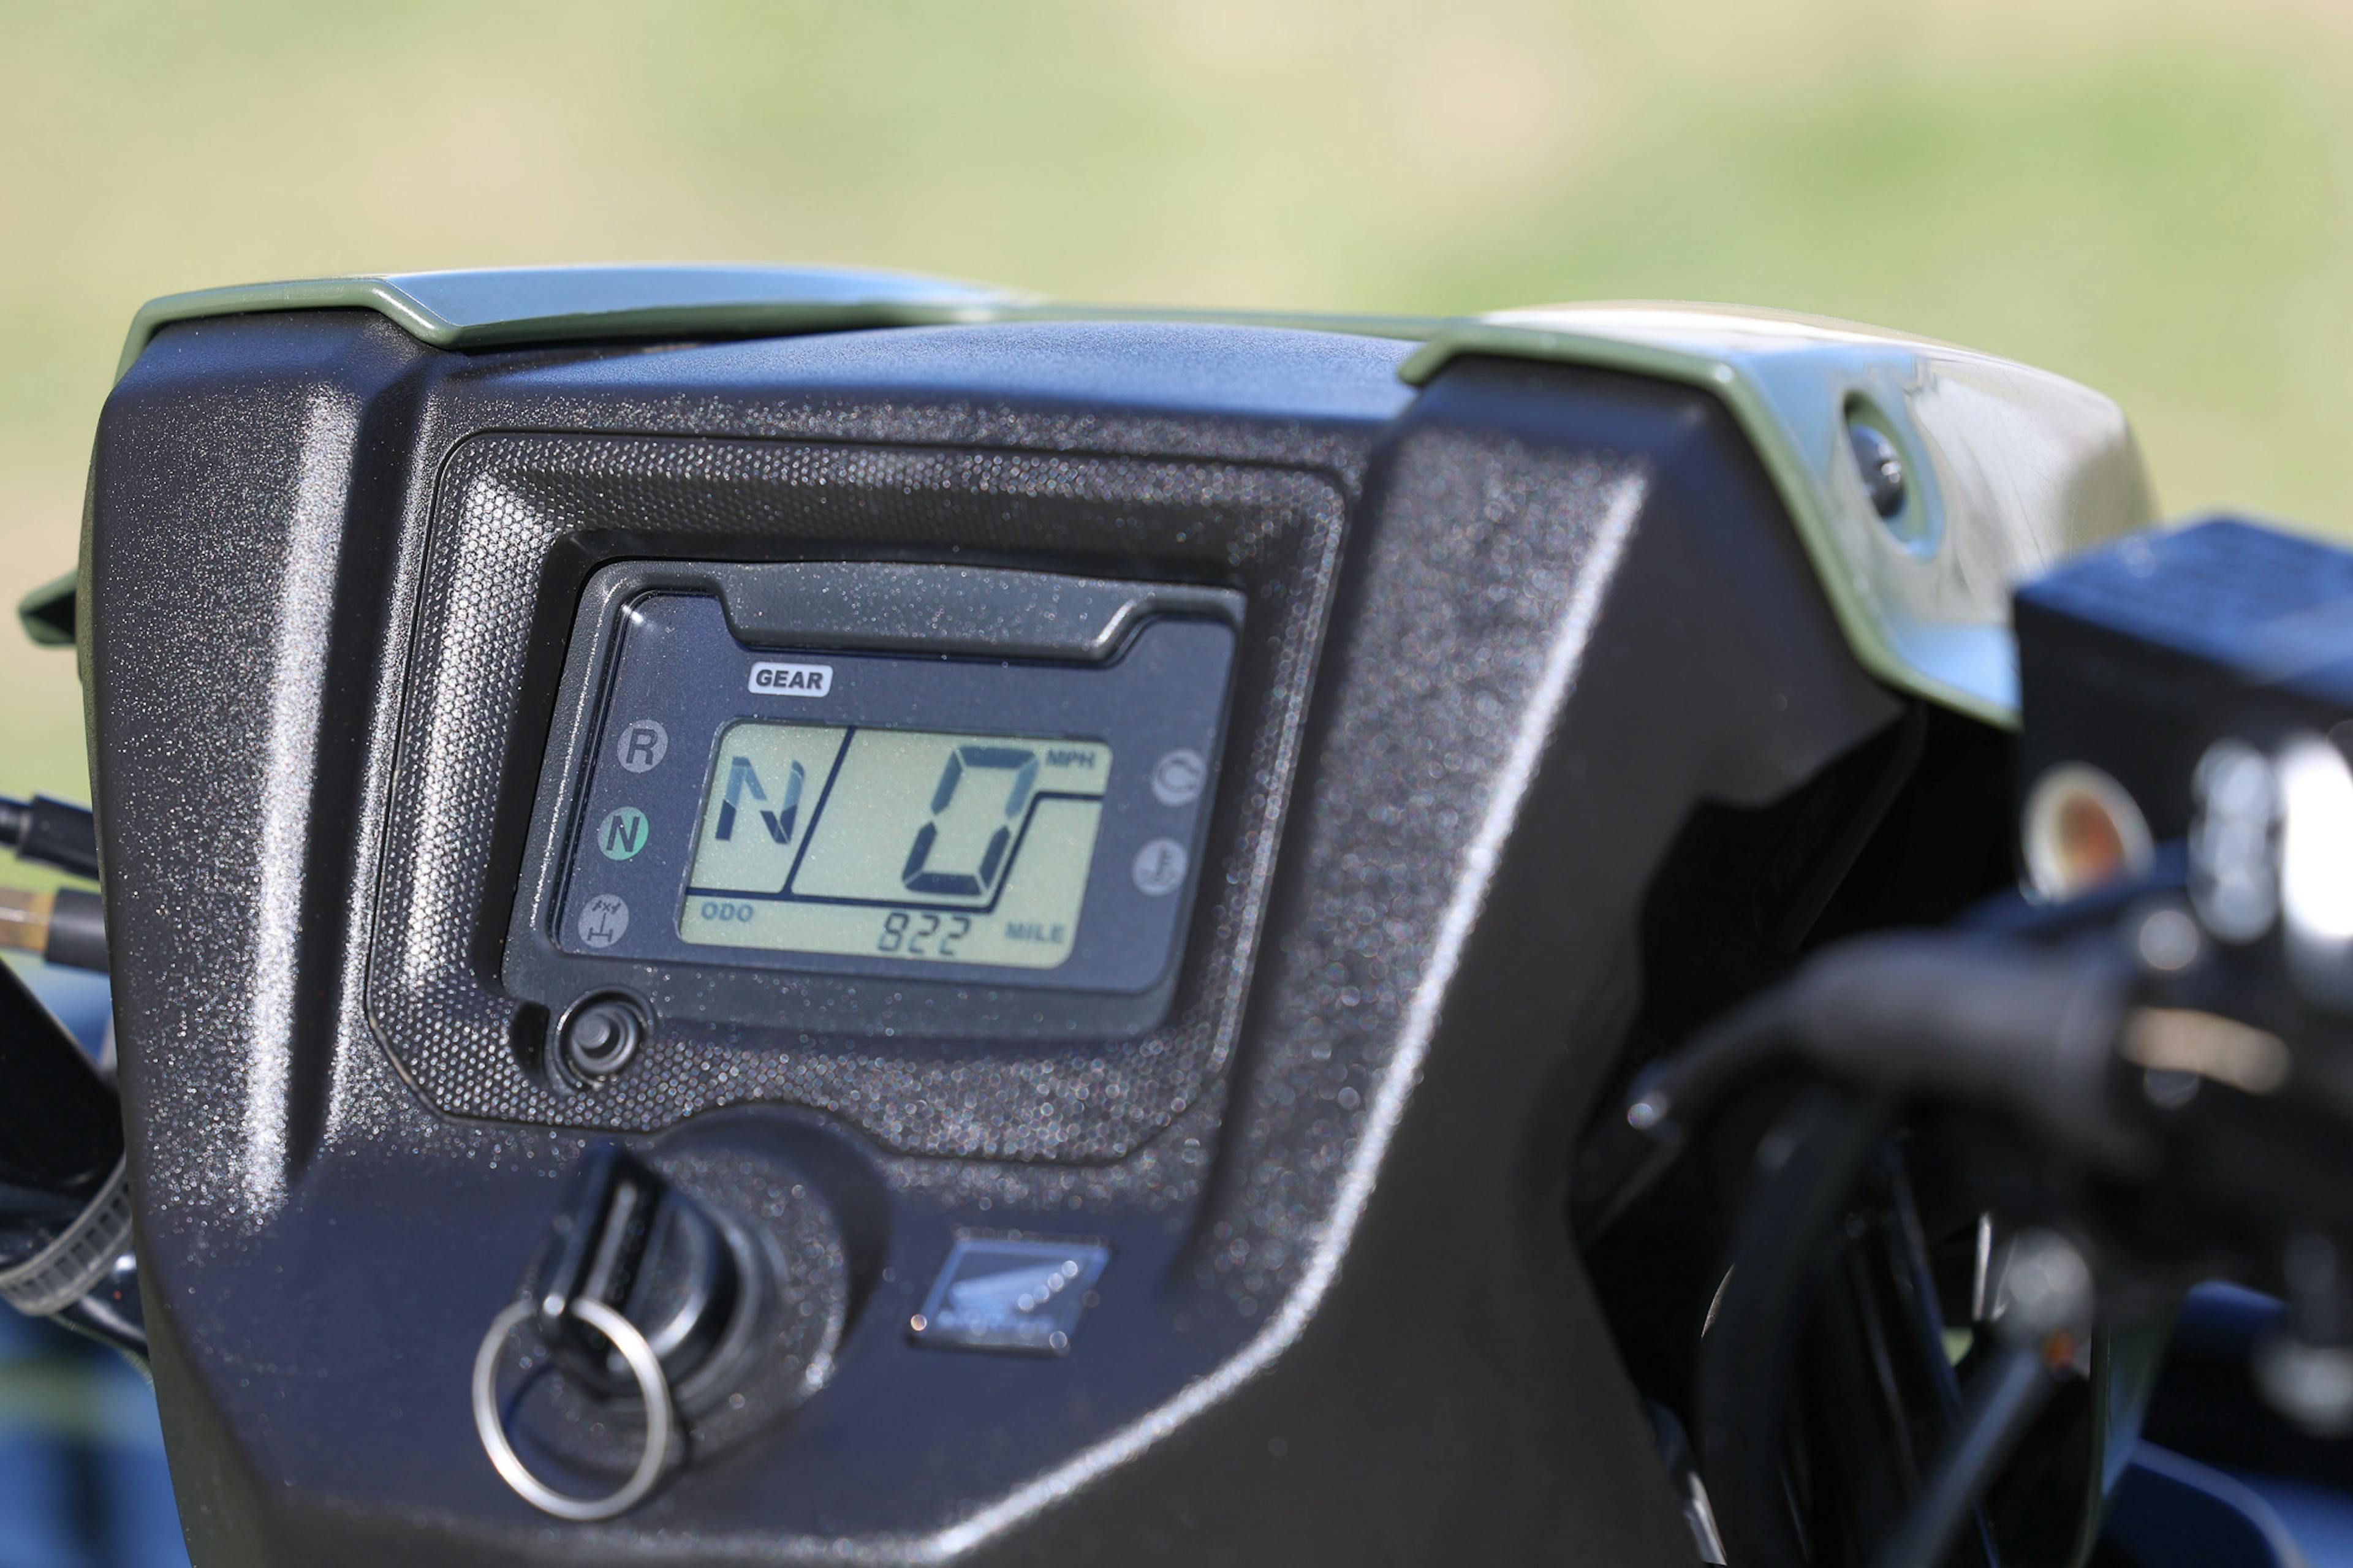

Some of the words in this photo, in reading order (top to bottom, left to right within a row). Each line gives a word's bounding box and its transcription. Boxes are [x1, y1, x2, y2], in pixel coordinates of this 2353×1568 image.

[756, 668, 824, 690] GEAR
[626, 728, 658, 765] R
[715, 755, 805, 845] N
[901, 745, 1039, 896] 0
[1045, 749, 1096, 769] MPH
[606, 815, 640, 853] N
[700, 901, 754, 923] ODO
[877, 911, 971, 956] 822
[1006, 920, 1066, 944] MILE
